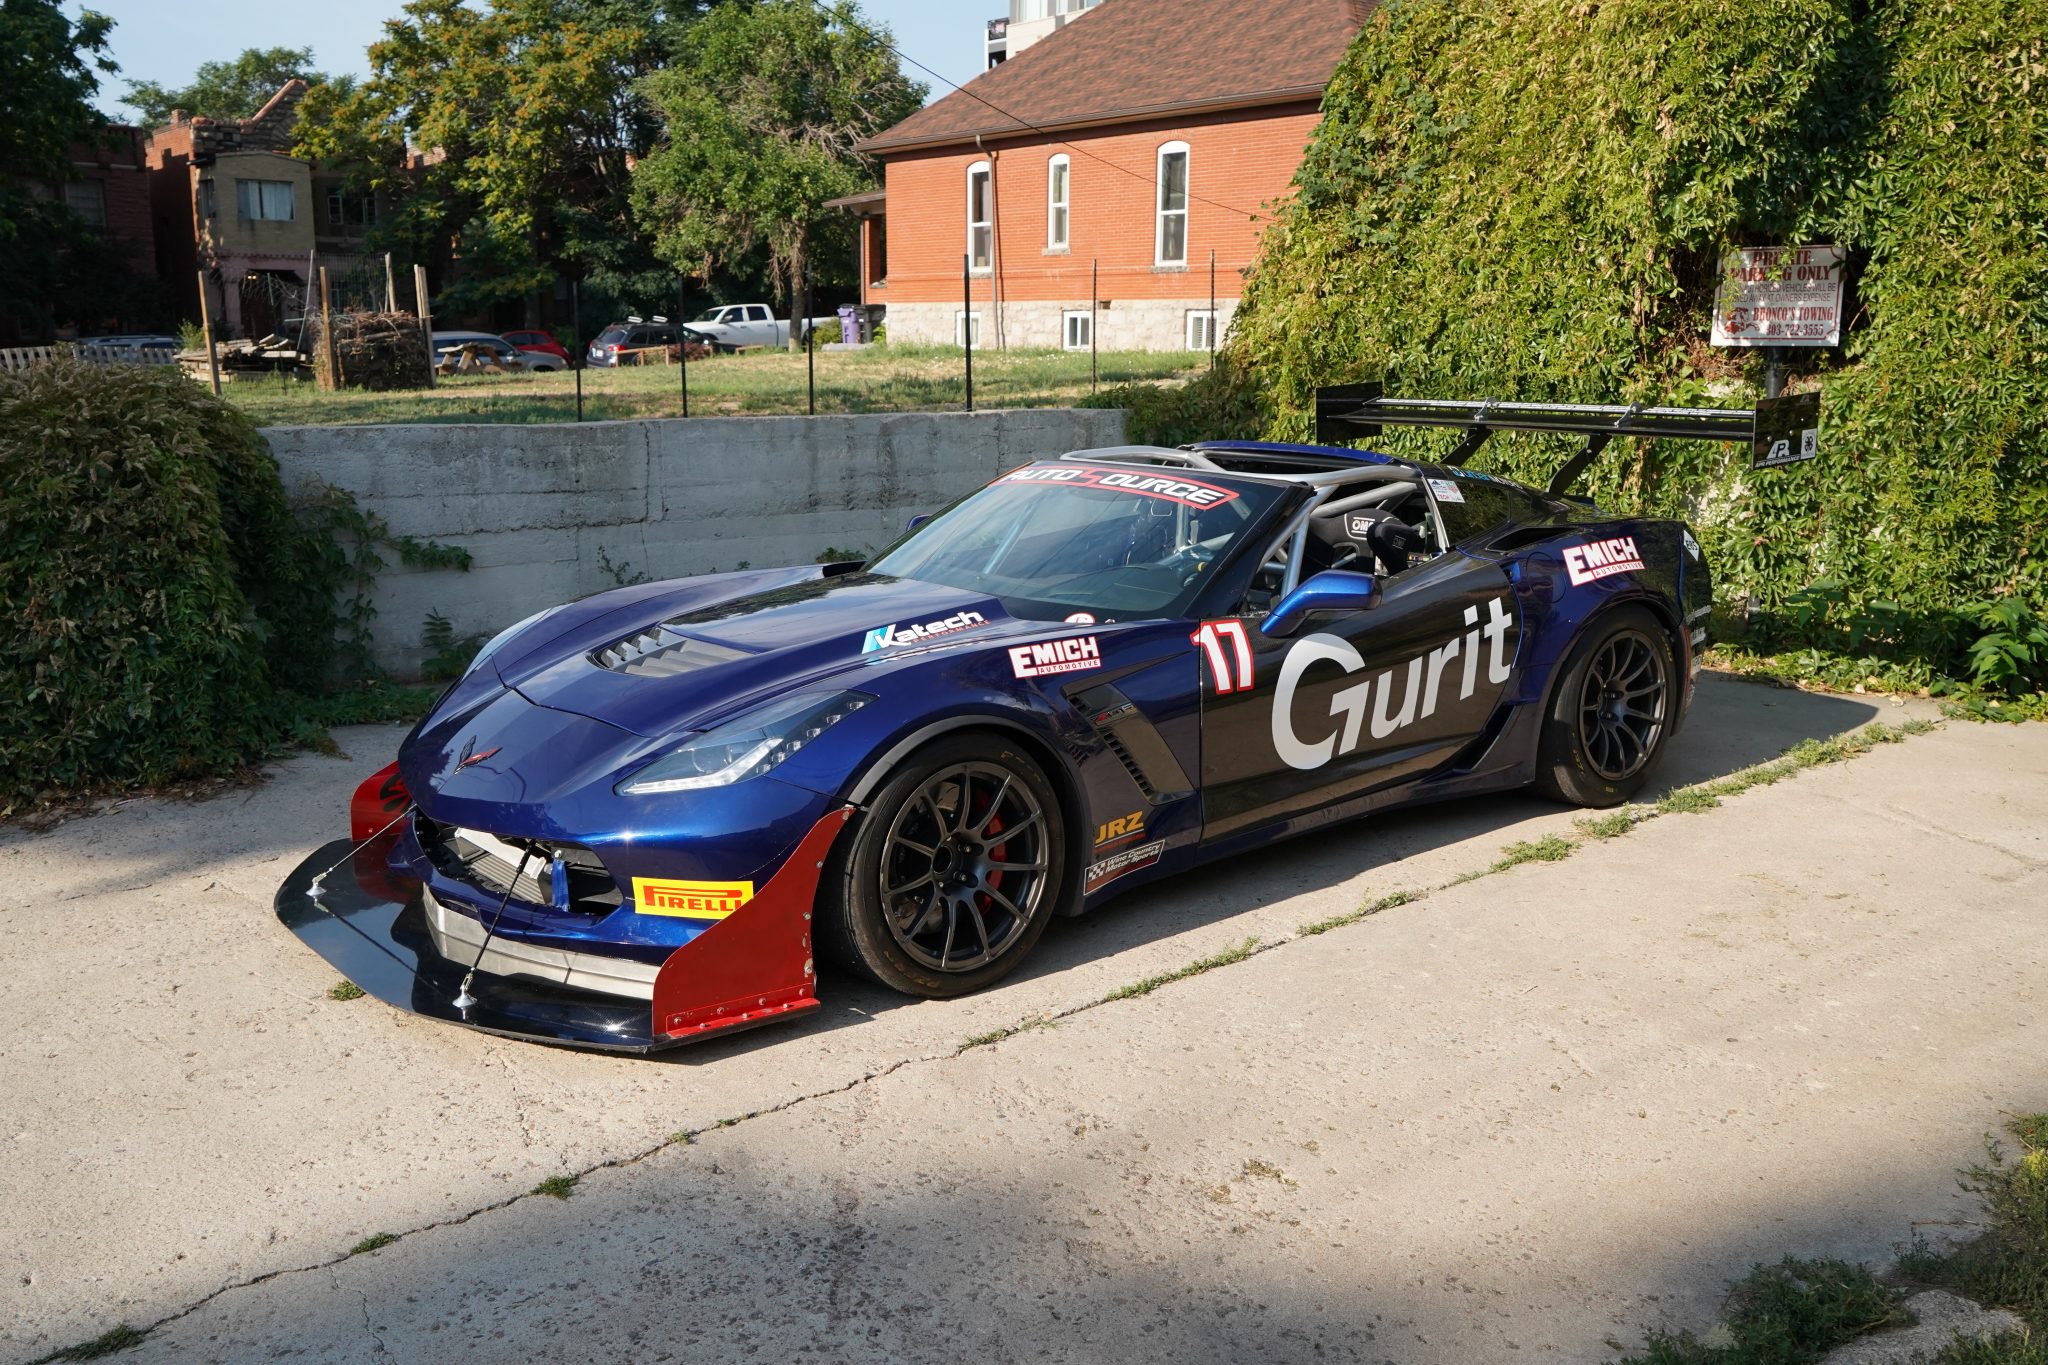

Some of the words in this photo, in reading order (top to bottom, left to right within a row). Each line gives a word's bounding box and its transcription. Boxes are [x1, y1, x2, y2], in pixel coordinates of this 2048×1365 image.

[1753, 250, 1812, 265] PRITE
[1730, 266, 1792, 281] PARKG
[1798, 265, 1831, 281] ONLY
[1776, 293, 1802, 302] OWNERS
[1803, 292, 1831, 302] EXPENSE
[1828, 282, 1836, 292] BE
[1753, 306, 1796, 321] BRONCO'S
[1799, 307, 1834, 321] TOWING
[1562, 537, 1640, 587] EMICH
[1595, 562, 1643, 577] AUTOMOTIVE
[870, 611, 984, 650] Katech
[912, 619, 991, 643] PERFORMANCE
[1008, 636, 1099, 679] EMICH
[1039, 659, 1099, 675] AUTOMOTIVE
[1190, 618, 1255, 695] 17
[1271, 597, 1513, 770] Gurit
[1095, 810, 1144, 845] JRZ
[643, 885, 742, 911] PIRELLI
